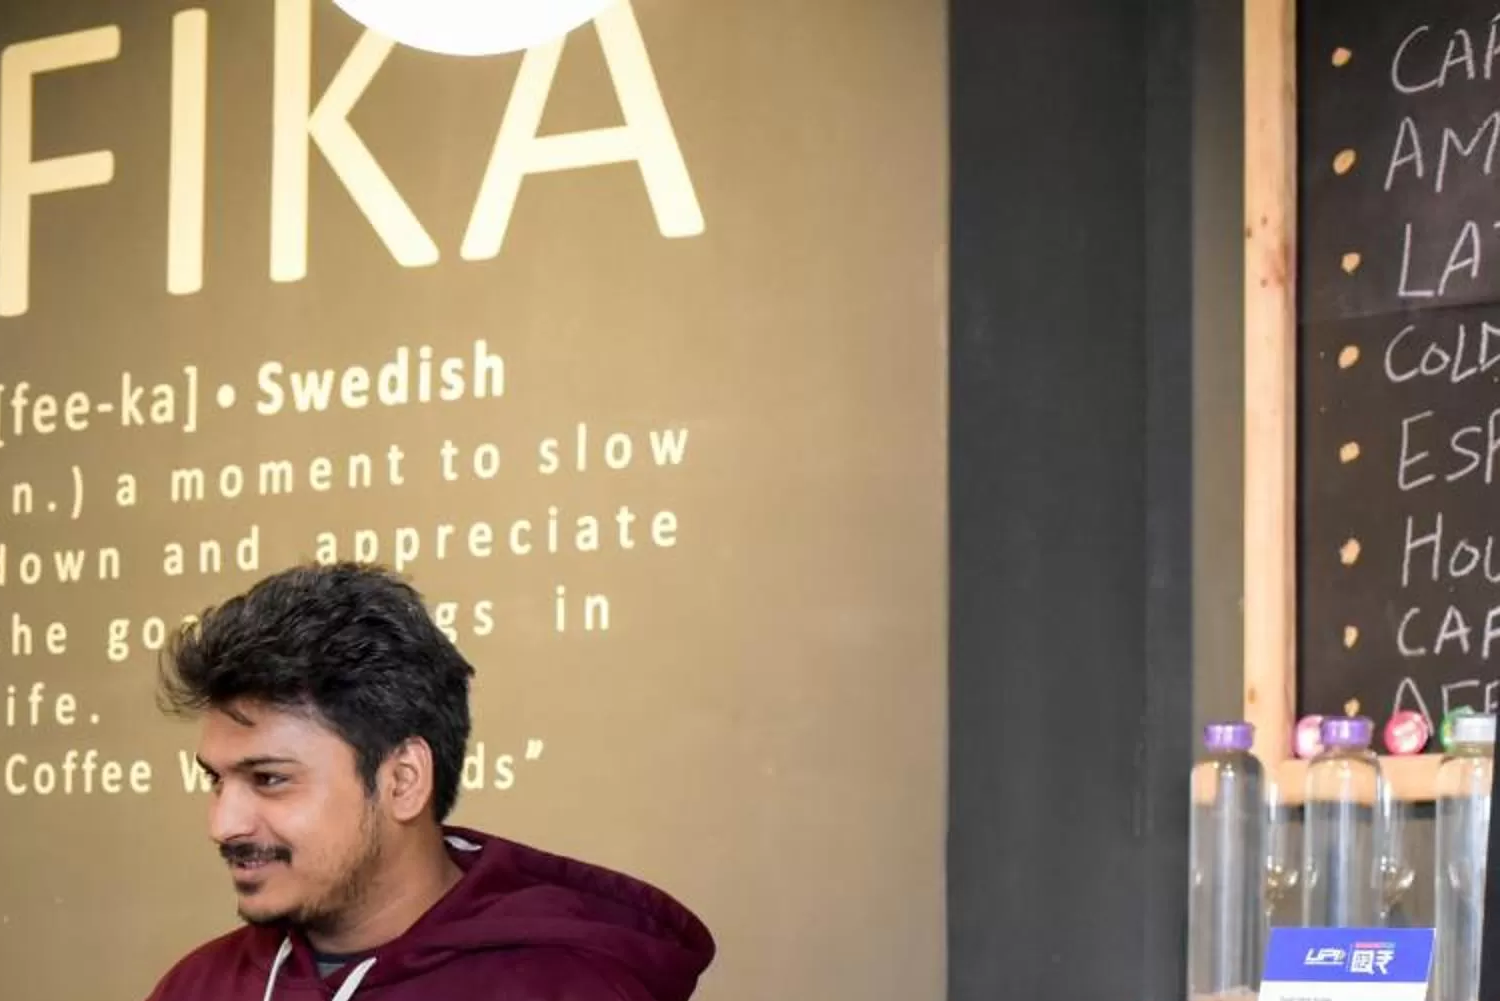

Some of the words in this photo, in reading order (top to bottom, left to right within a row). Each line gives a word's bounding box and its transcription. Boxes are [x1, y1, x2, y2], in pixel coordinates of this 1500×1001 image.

[1398, 221, 1500, 297] LA
[256, 340, 506, 415] Swedish
[115, 469, 137, 508] a
[170, 443, 406, 504] moment
[440, 440, 501, 482] to
[538, 422, 689, 474] slow
[162, 526, 261, 576] and
[315, 507, 680, 572] appreciate
[554, 585, 611, 633] in
